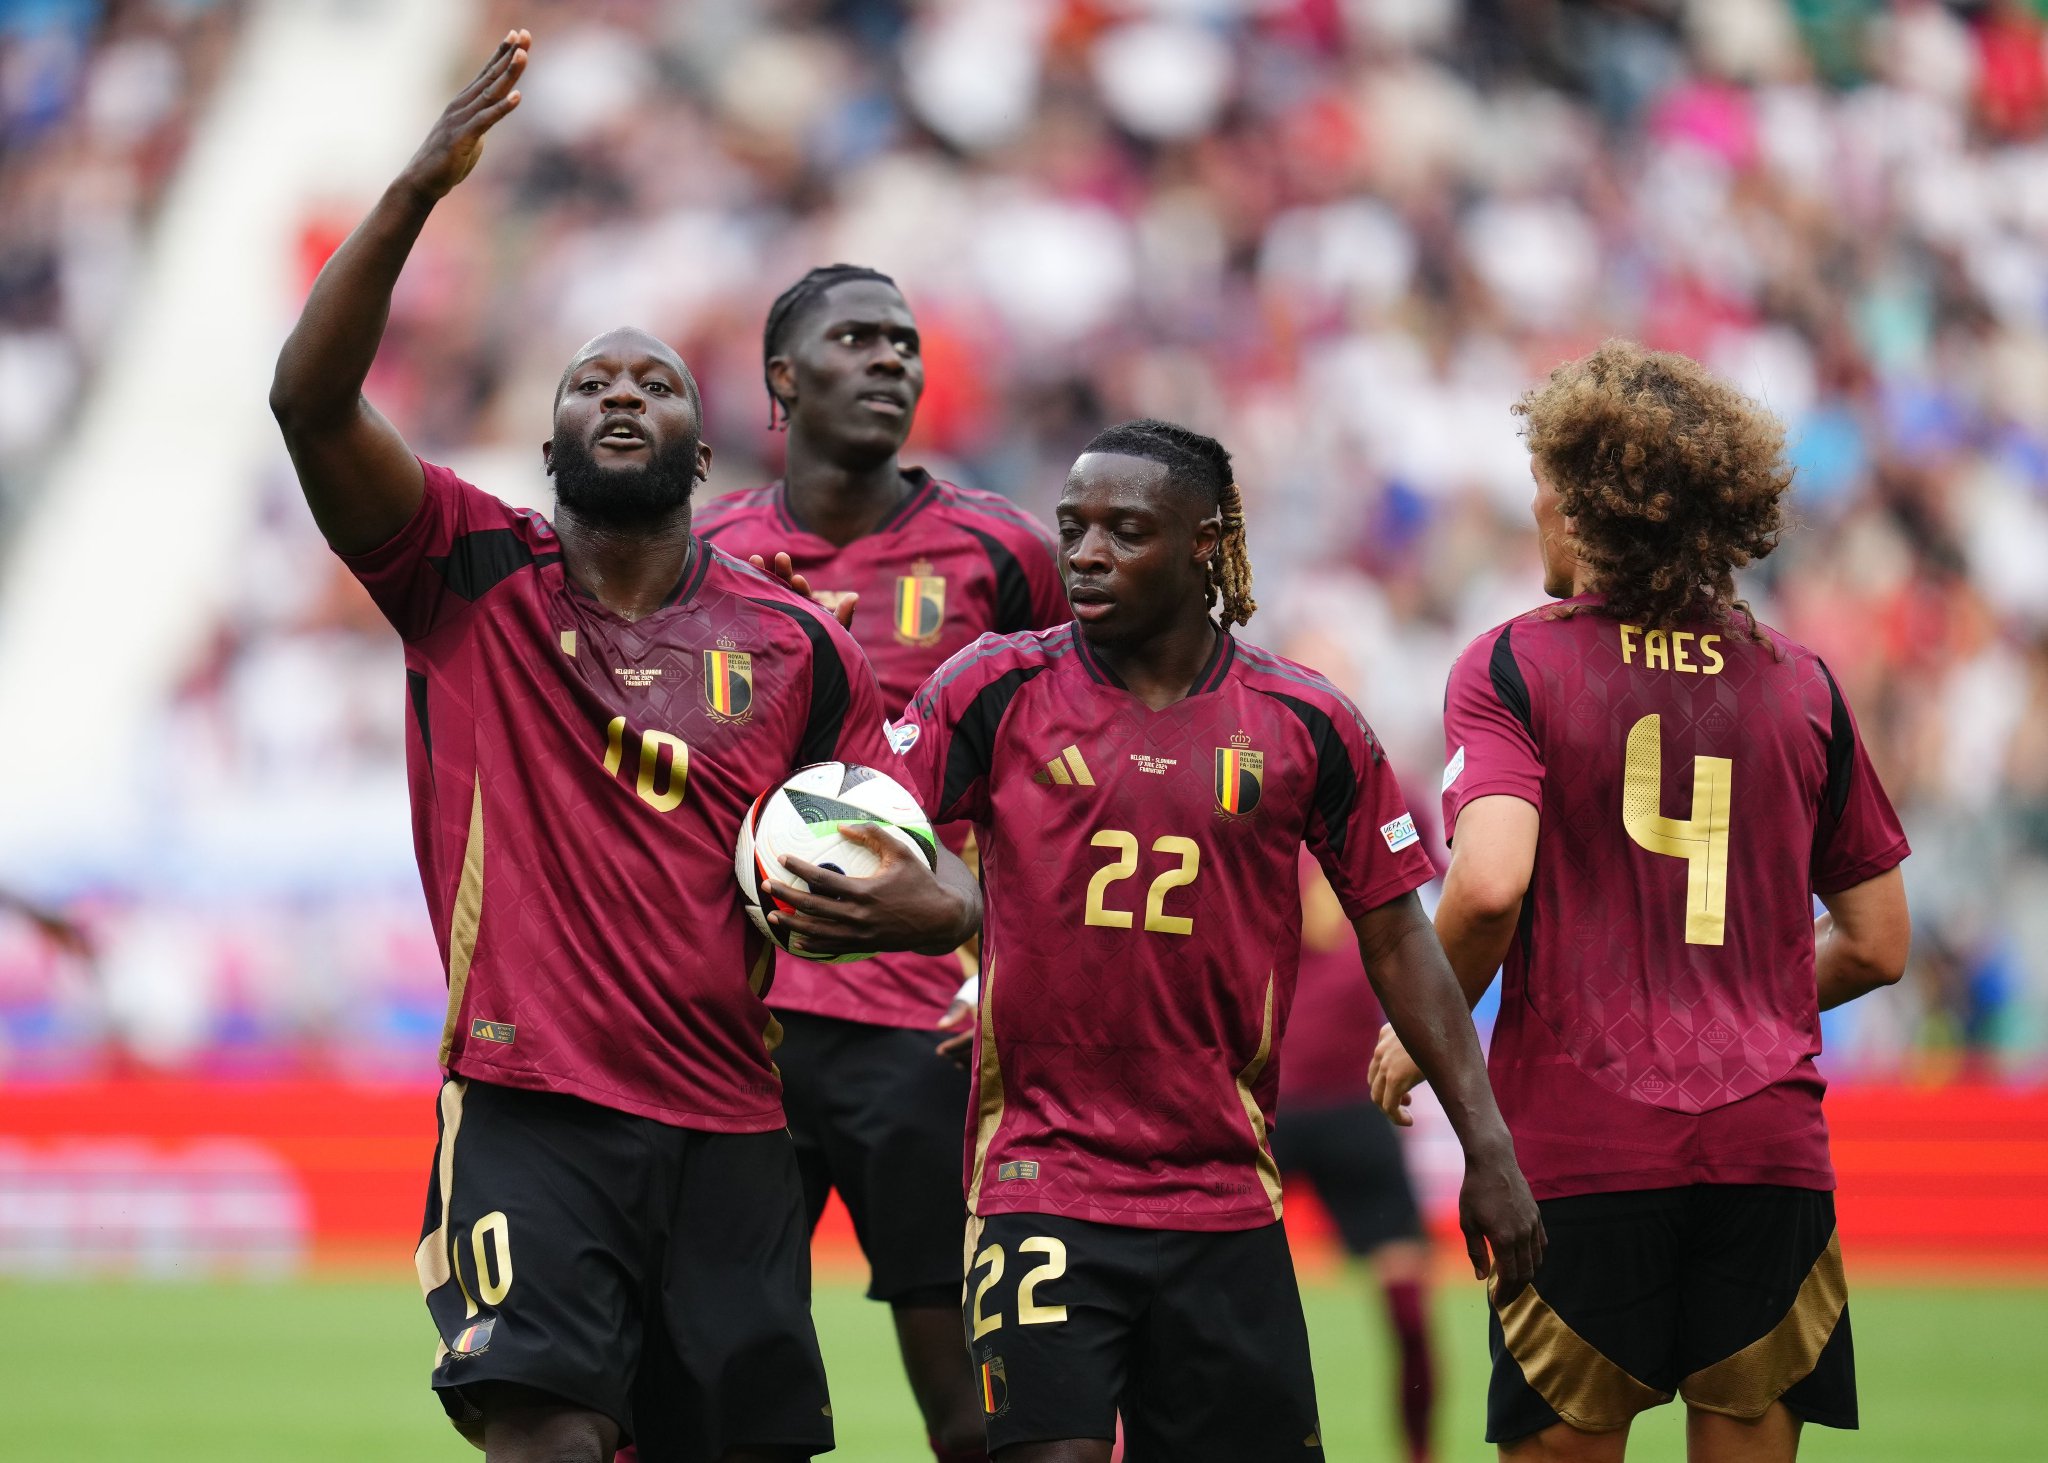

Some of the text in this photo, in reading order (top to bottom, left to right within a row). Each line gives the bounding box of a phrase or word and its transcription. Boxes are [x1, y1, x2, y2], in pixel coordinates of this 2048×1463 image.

[1619, 624, 1724, 674] FAES
[603, 716, 688, 813] 10
[1240, 756, 1263, 764] BELGIAN
[1383, 820, 1401, 833] UEFA
[1622, 713, 1732, 945] 4
[1084, 829, 1200, 936] 22
[973, 1236, 1068, 1342] 22
